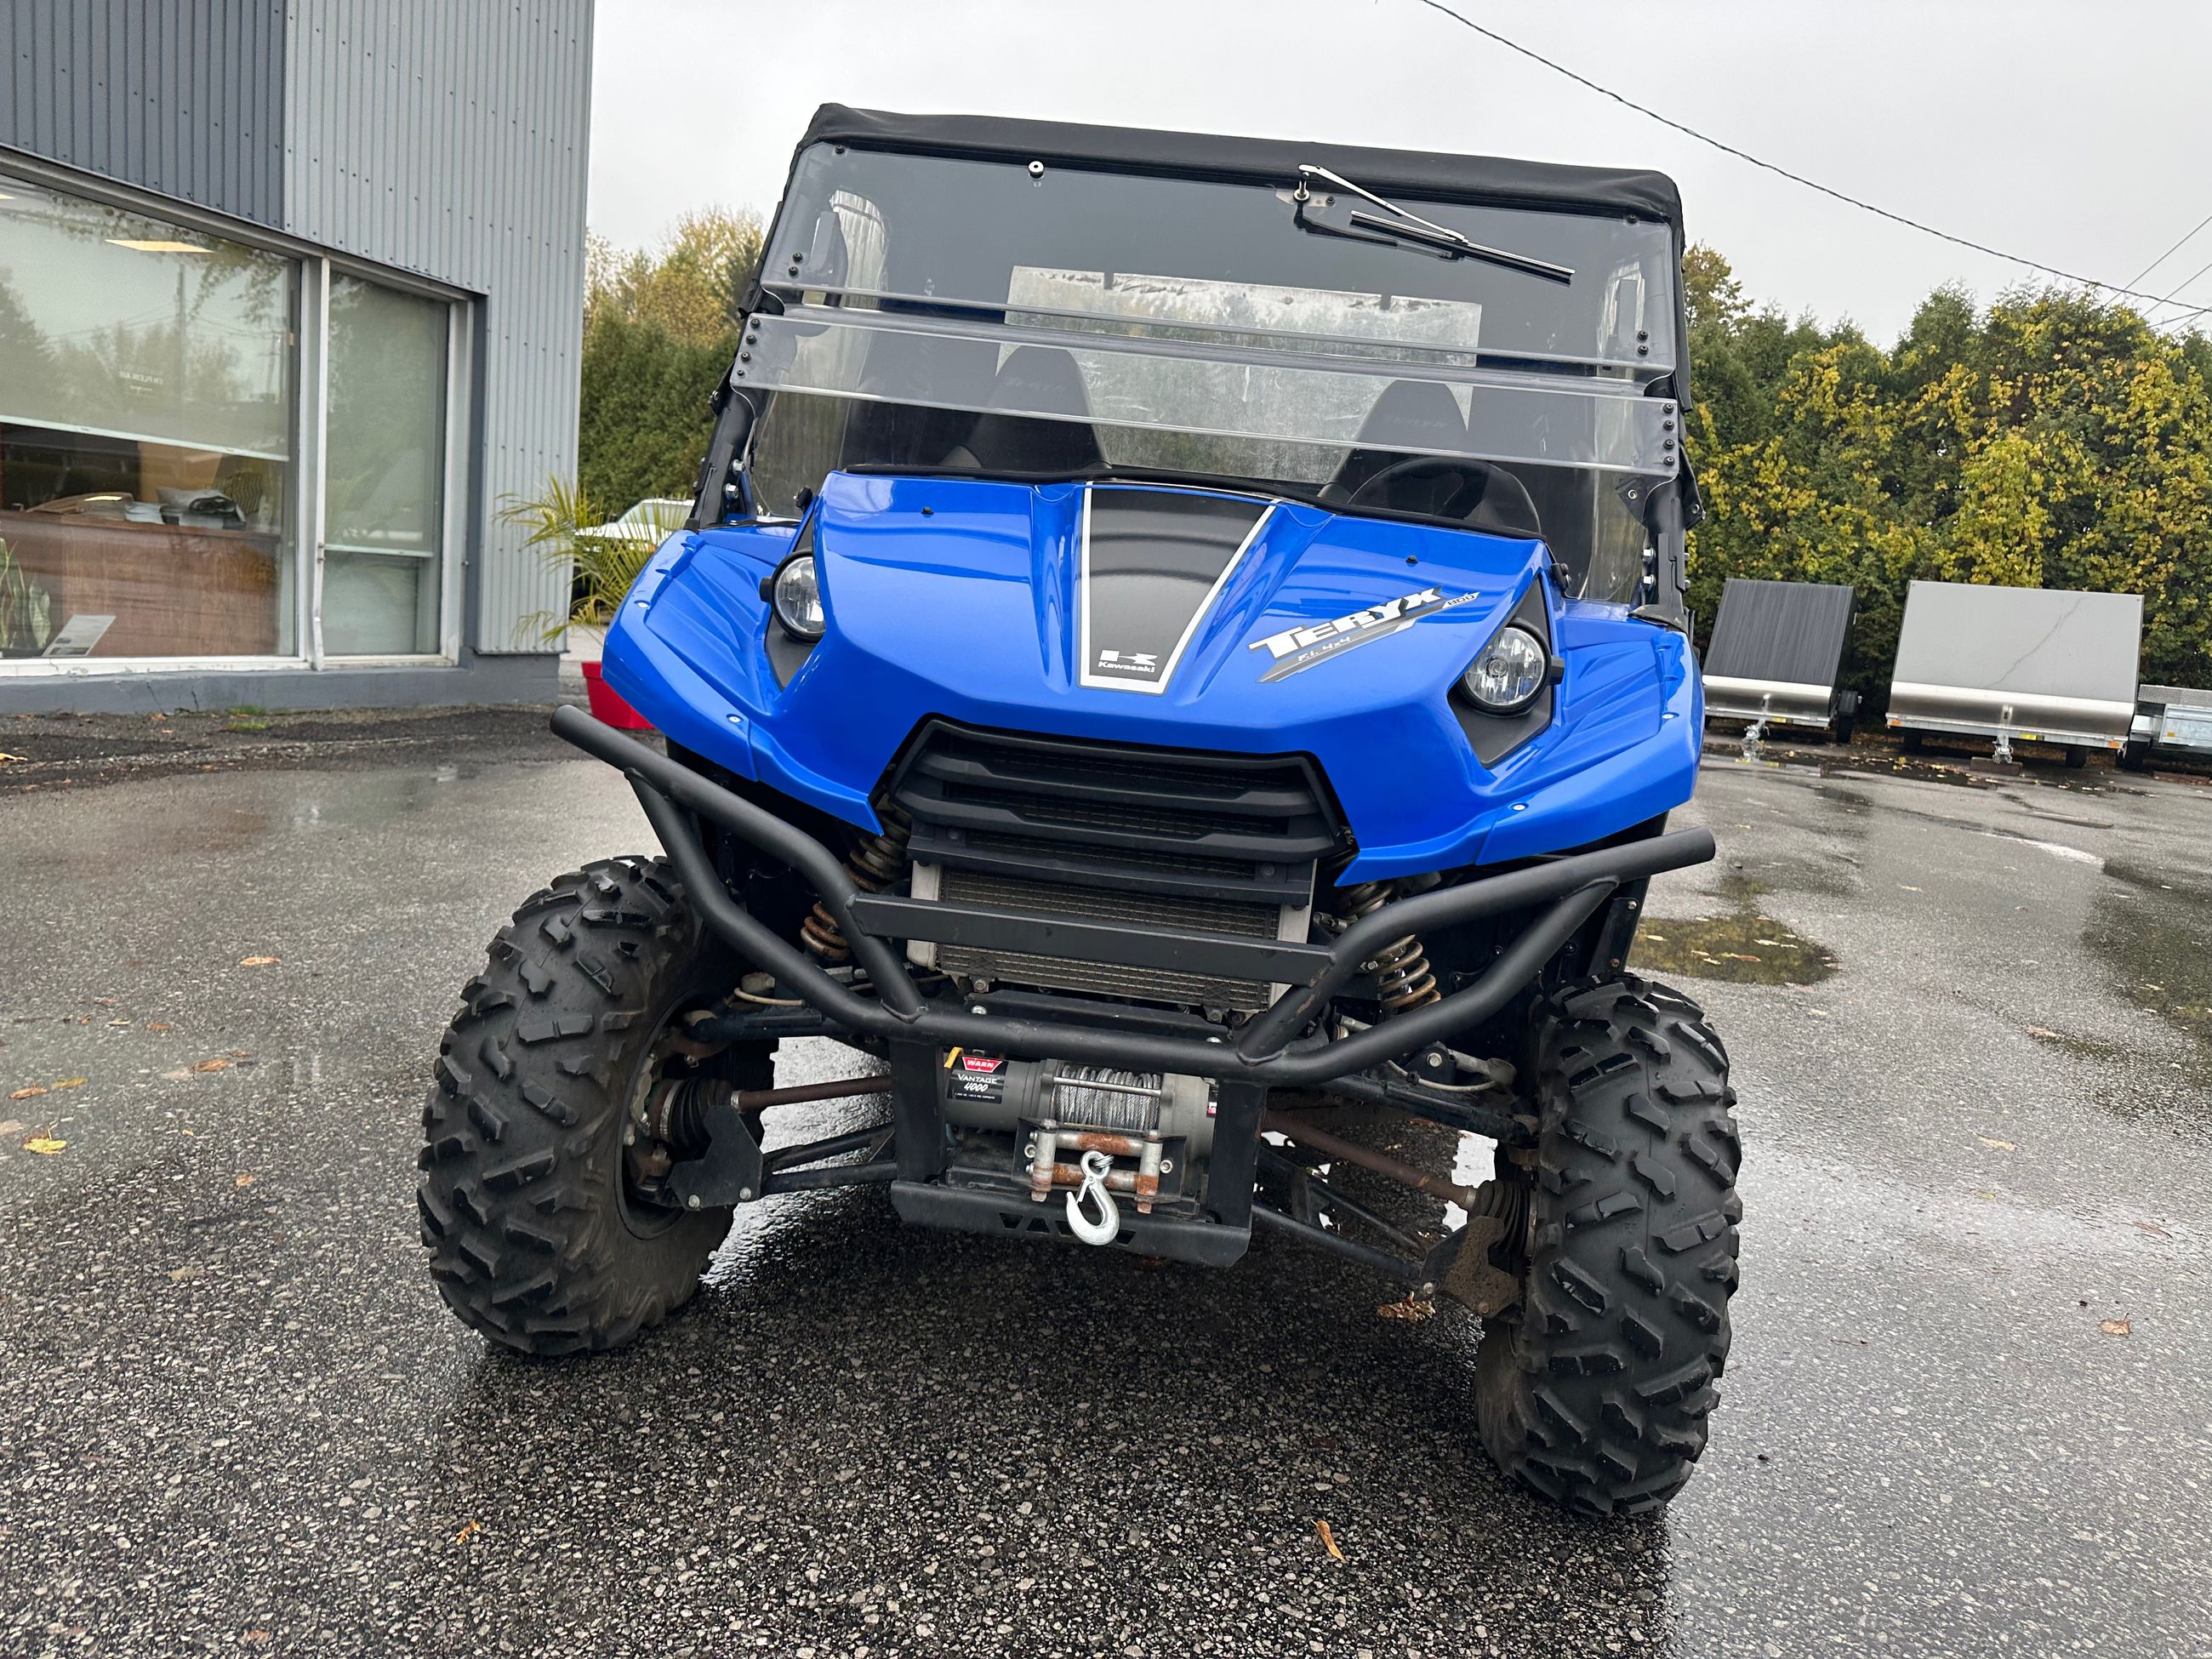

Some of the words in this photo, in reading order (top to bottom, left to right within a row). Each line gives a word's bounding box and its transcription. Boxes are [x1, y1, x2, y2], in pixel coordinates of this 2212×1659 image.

[1248, 588, 1441, 658] TERYX
[1322, 636, 1351, 651] 4x4
[1097, 661, 1155, 673] Kawasaki
[966, 1059, 995, 1069] WARN
[957, 1073, 998, 1085] VANTAGE
[963, 1081, 989, 1092] 4000
